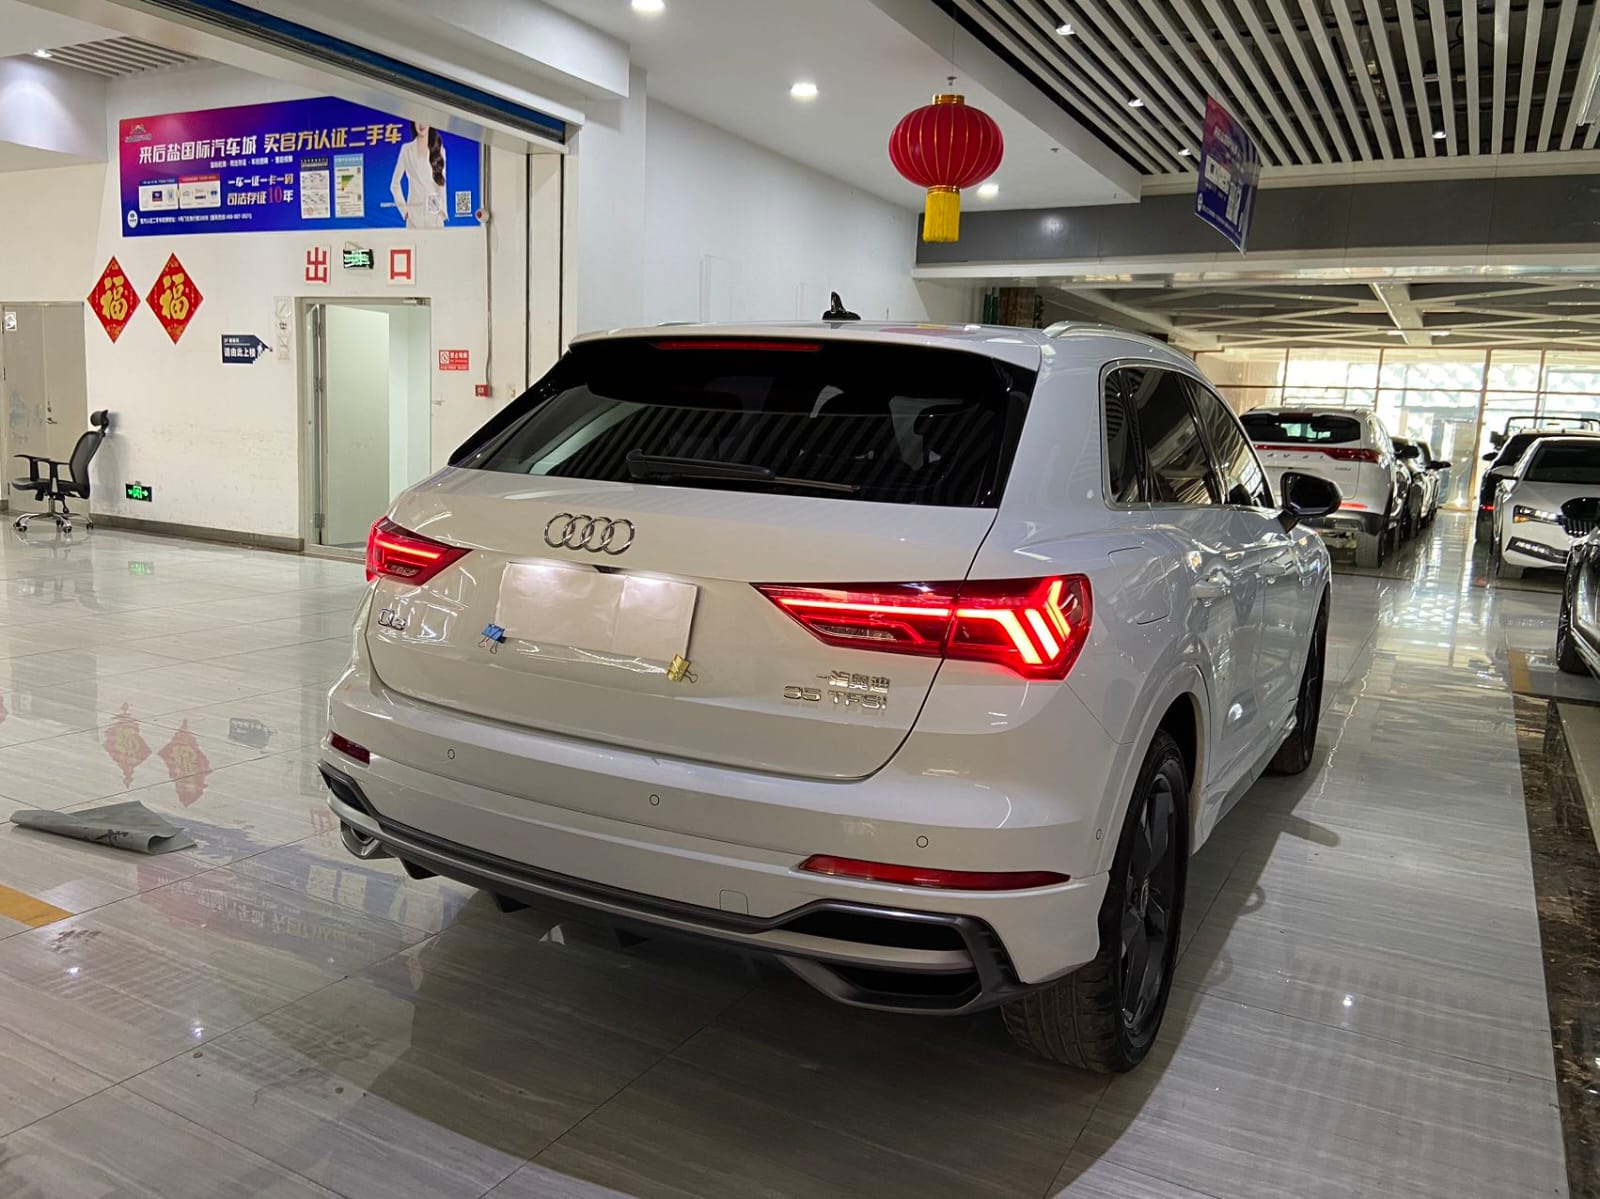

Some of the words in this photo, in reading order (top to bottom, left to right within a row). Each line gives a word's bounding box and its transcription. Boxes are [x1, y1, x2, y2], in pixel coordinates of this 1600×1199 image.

[264, 123, 403, 154] 买官方认证二手车
[305, 247, 328, 283] 出
[389, 249, 412, 280] 口
[100, 275, 128, 321] 福
[160, 273, 189, 321] 福
[783, 685, 822, 702] 35
